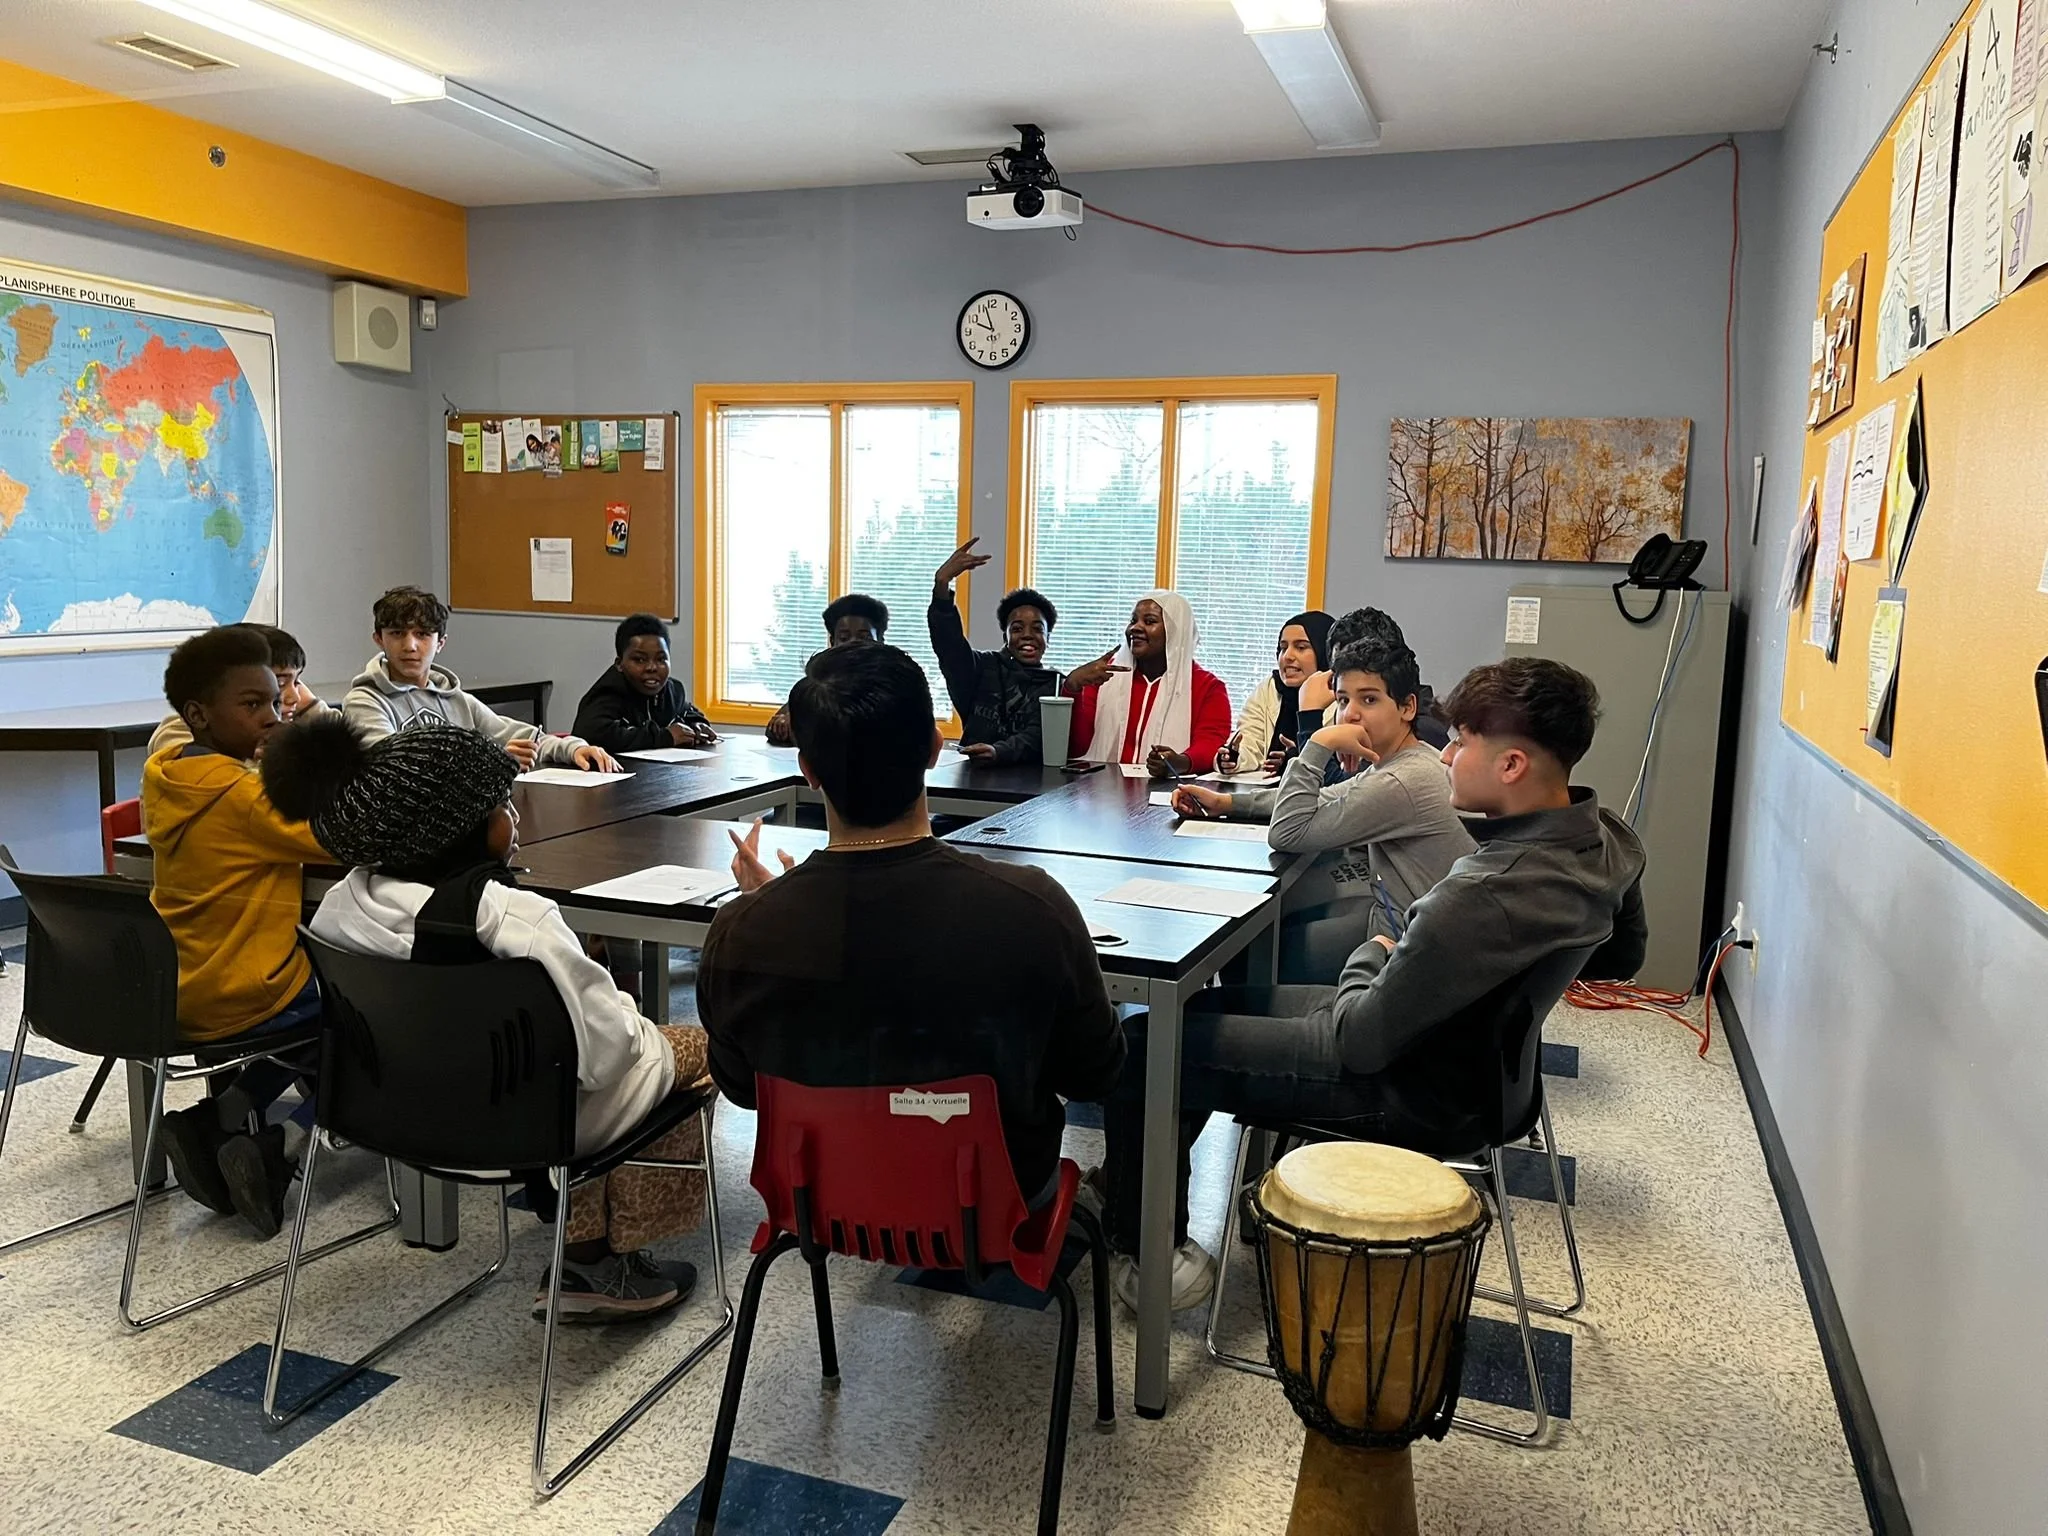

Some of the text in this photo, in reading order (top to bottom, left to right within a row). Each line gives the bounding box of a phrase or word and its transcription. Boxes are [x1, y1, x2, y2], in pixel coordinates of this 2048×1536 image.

[80, 289, 136, 309] POLITIQUE
[978, 304, 985, 313] 11
[987, 299, 997, 309] 12
[968, 314, 978, 324] 10
[1011, 311, 1018, 321] 2
[965, 328, 972, 337] 9
[1014, 324, 1021, 333] 3
[969, 341, 976, 350] 8
[1010, 338, 1017, 347] 4
[978, 350, 985, 360] 7
[990, 352, 997, 361] 6
[1002, 349, 1009, 358] 5
[932, 1097, 968, 1105] Virtuelle
